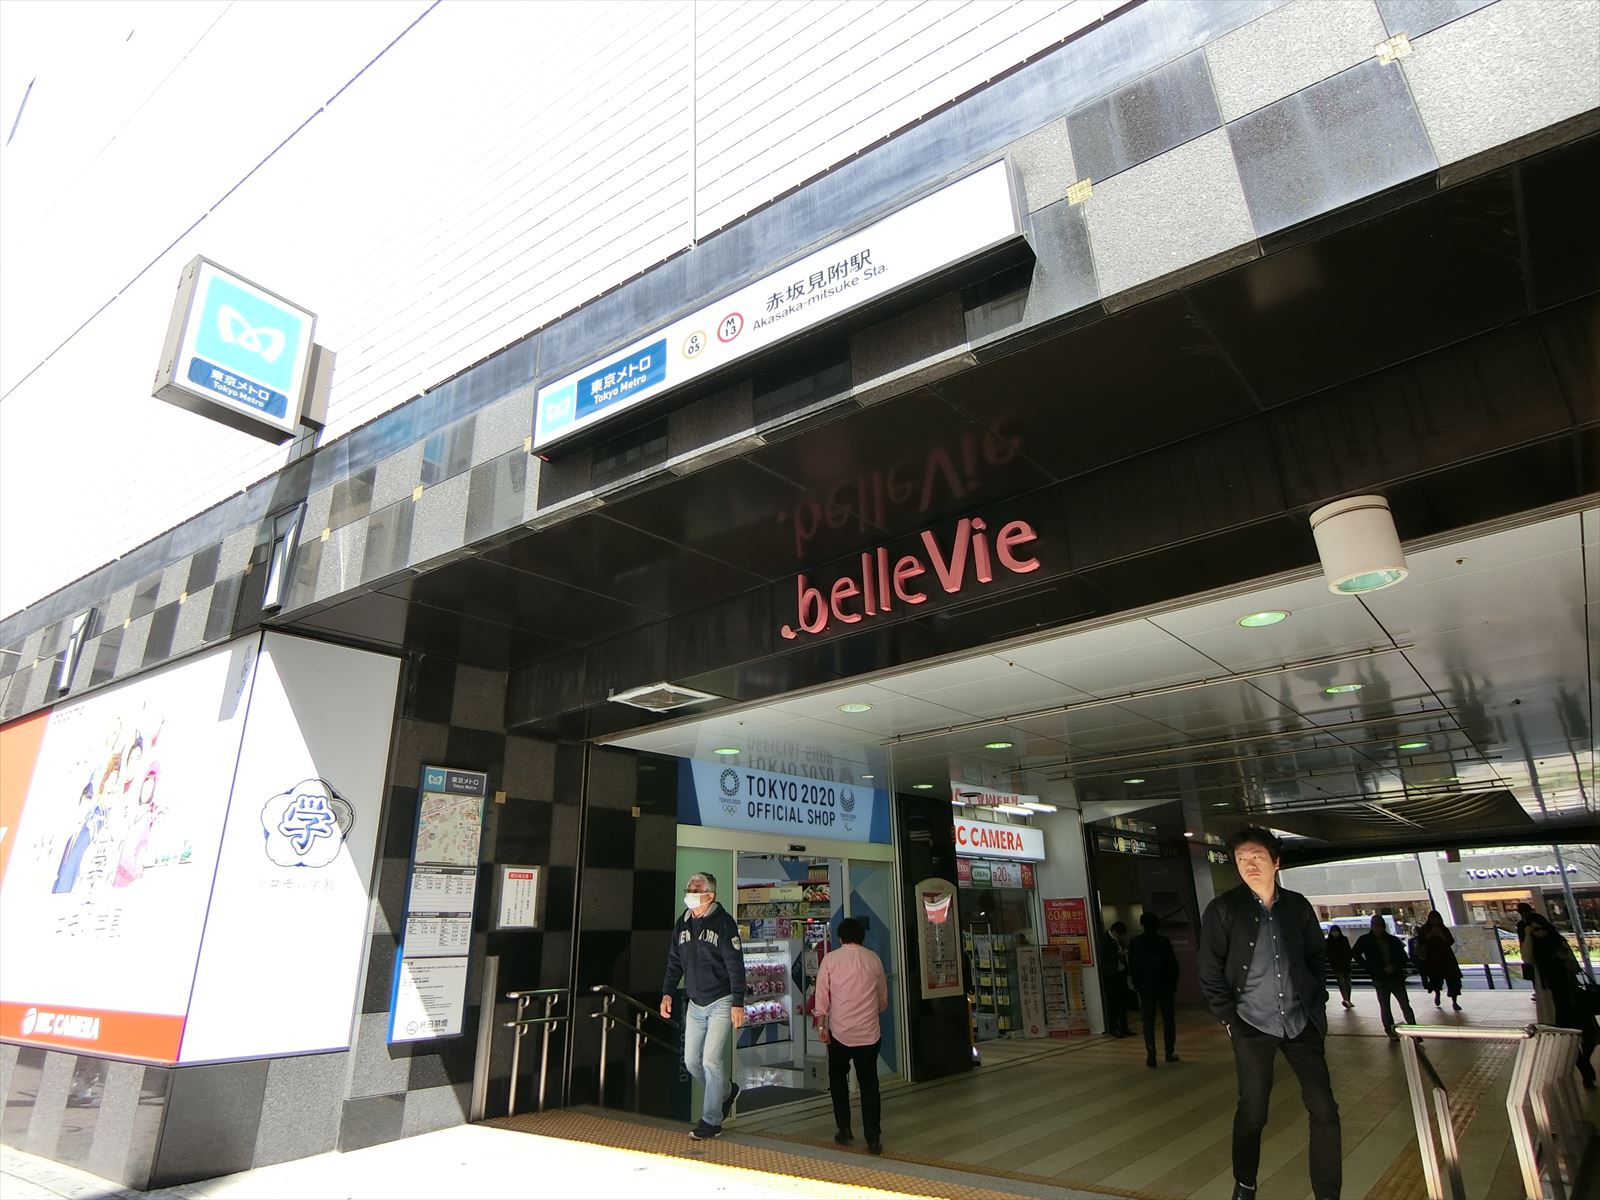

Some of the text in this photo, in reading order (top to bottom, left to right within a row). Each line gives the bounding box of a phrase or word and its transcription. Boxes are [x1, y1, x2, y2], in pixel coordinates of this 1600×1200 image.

[766, 249, 872, 312] 赤坂見附駅
[753, 264, 889, 331] Akasaka-mitsuke Sta.
[724, 325, 737, 338] 13
[725, 317, 735, 327] M
[687, 343, 700, 355] 05
[690, 335, 698, 344] G
[210, 368, 270, 401] 東京メトロ
[591, 355, 651, 395] 東京メトロ
[213, 380, 264, 408] Tokyo Metro
[593, 375, 647, 405] Tokyo Metro
[451, 776, 480, 786] 東京メトロ
[746, 775, 835, 807] TOKYO 2020
[281, 796, 334, 854] 学
[747, 801, 804, 823] OFFICIAL
[807, 809, 836, 827] SHOP
[970, 827, 1024, 851] CAMERA
[1466, 867, 1519, 880] TOKYU
